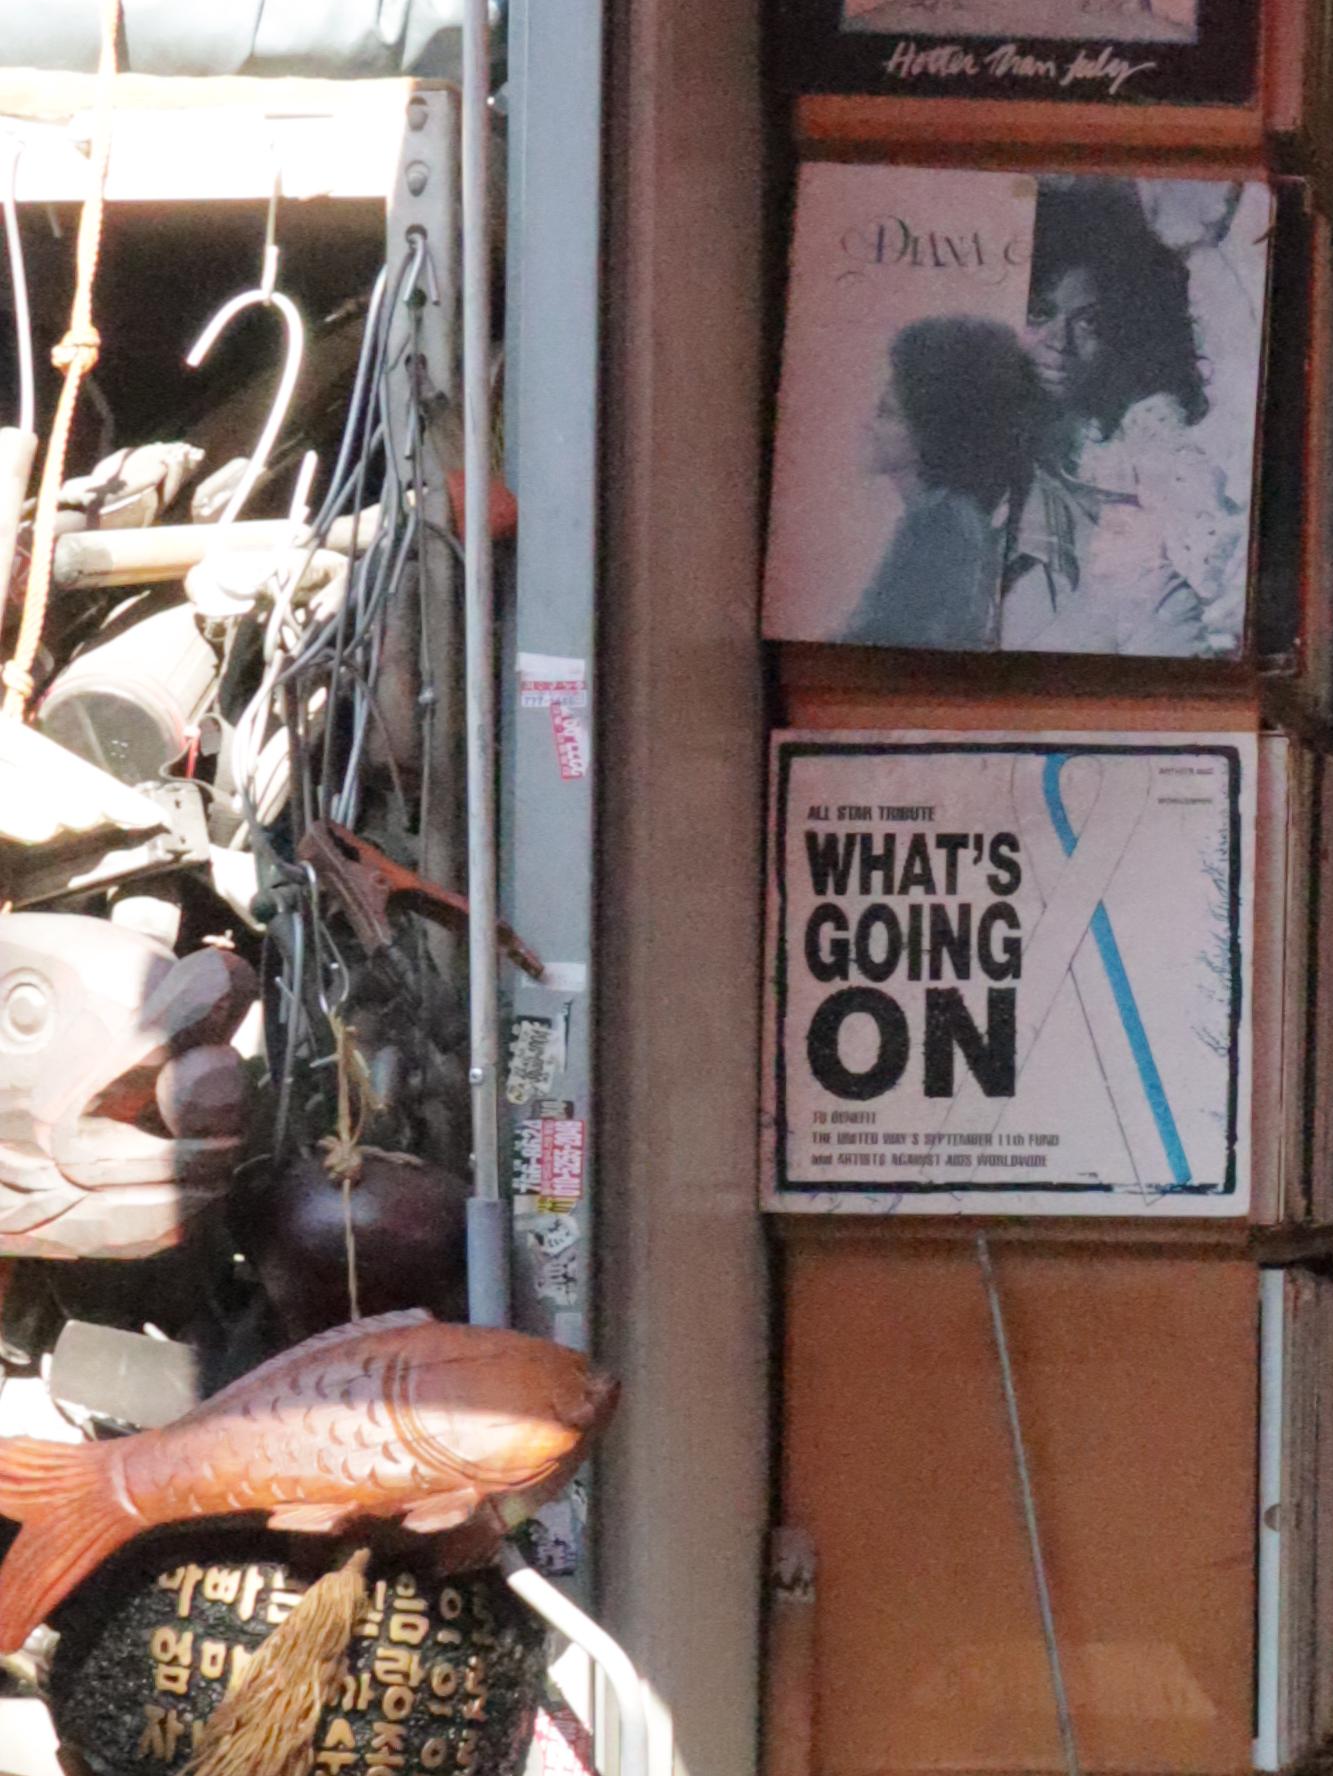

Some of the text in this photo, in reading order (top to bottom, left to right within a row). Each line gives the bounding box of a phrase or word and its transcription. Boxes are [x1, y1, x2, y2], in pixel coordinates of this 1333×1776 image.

[807, 805, 830, 822] ALL
[804, 830, 1023, 897] WHAT'S
[805, 901, 1023, 982] GOING
[806, 985, 1018, 1101] ON
